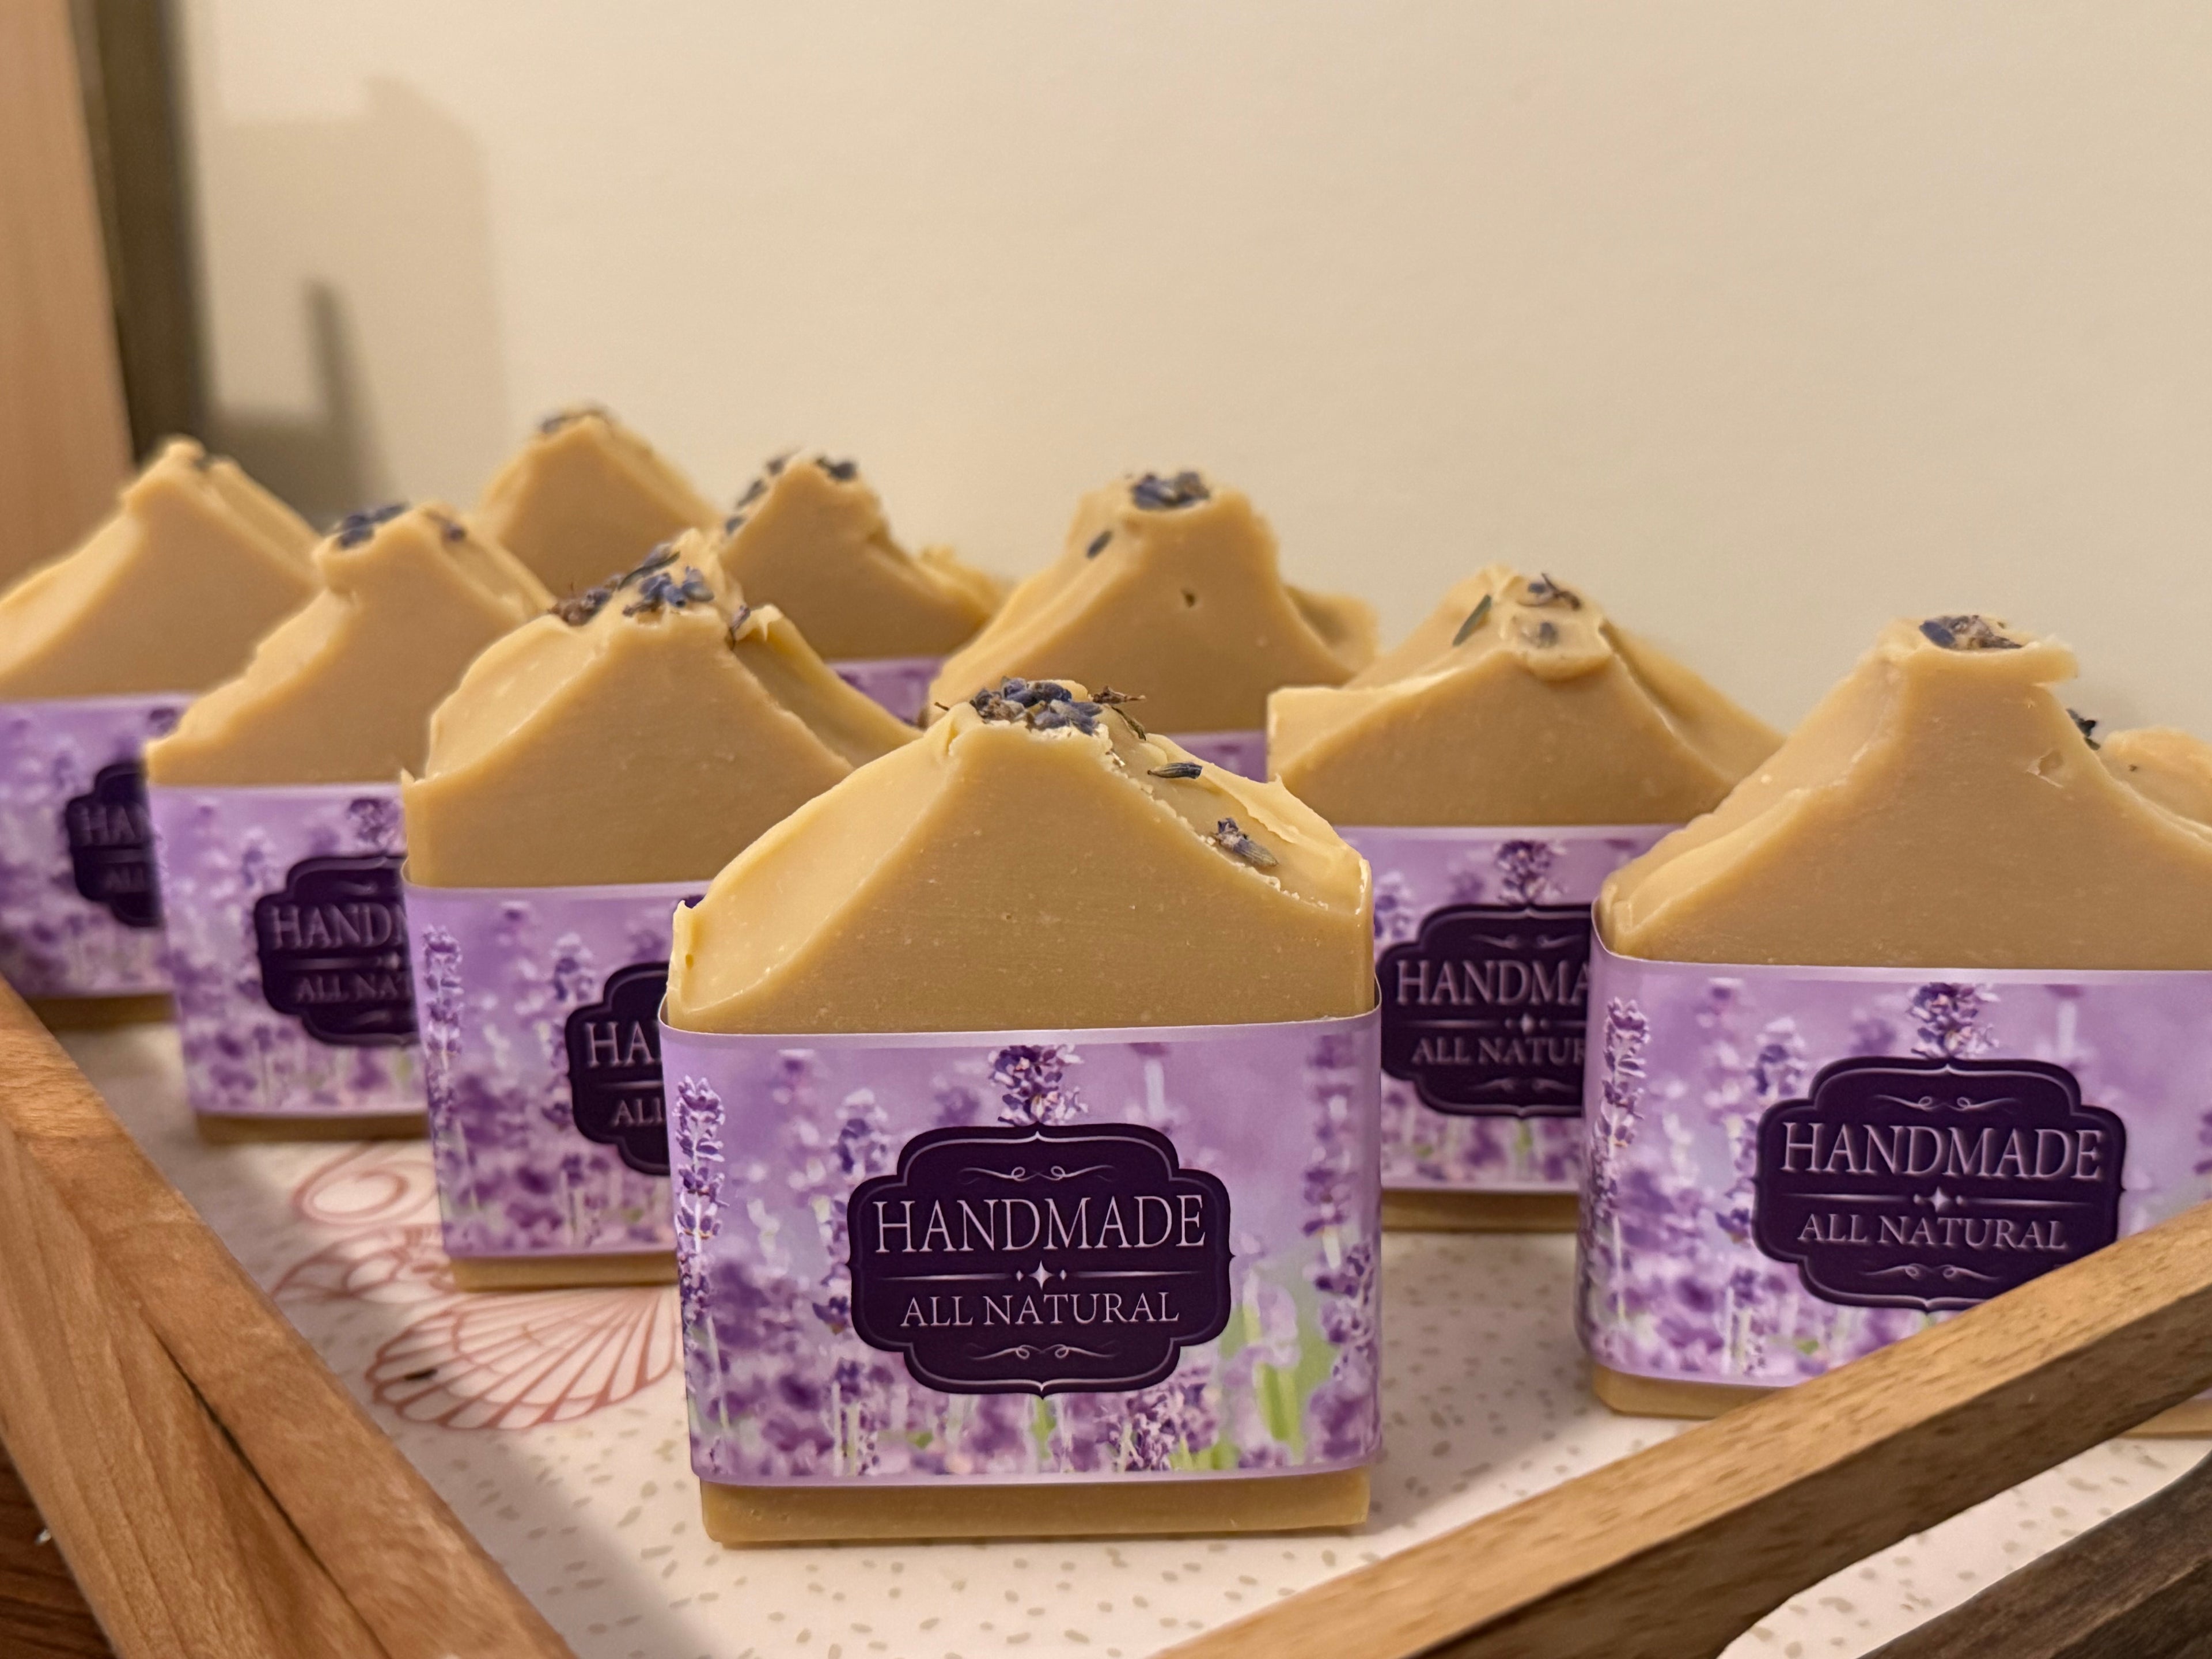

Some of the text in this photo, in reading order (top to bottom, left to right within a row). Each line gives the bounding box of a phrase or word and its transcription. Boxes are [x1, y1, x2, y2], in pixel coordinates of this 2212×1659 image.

[584, 1021, 662, 1067] HA
[1412, 1037, 1471, 1065] ALL
[1780, 1122, 2103, 1181] HANDMADE
[872, 1194, 1206, 1253] HANDMADE
[1797, 1213, 2069, 1251] ALL NATURAL
[900, 1291, 1180, 1327] ALL NATURAL
